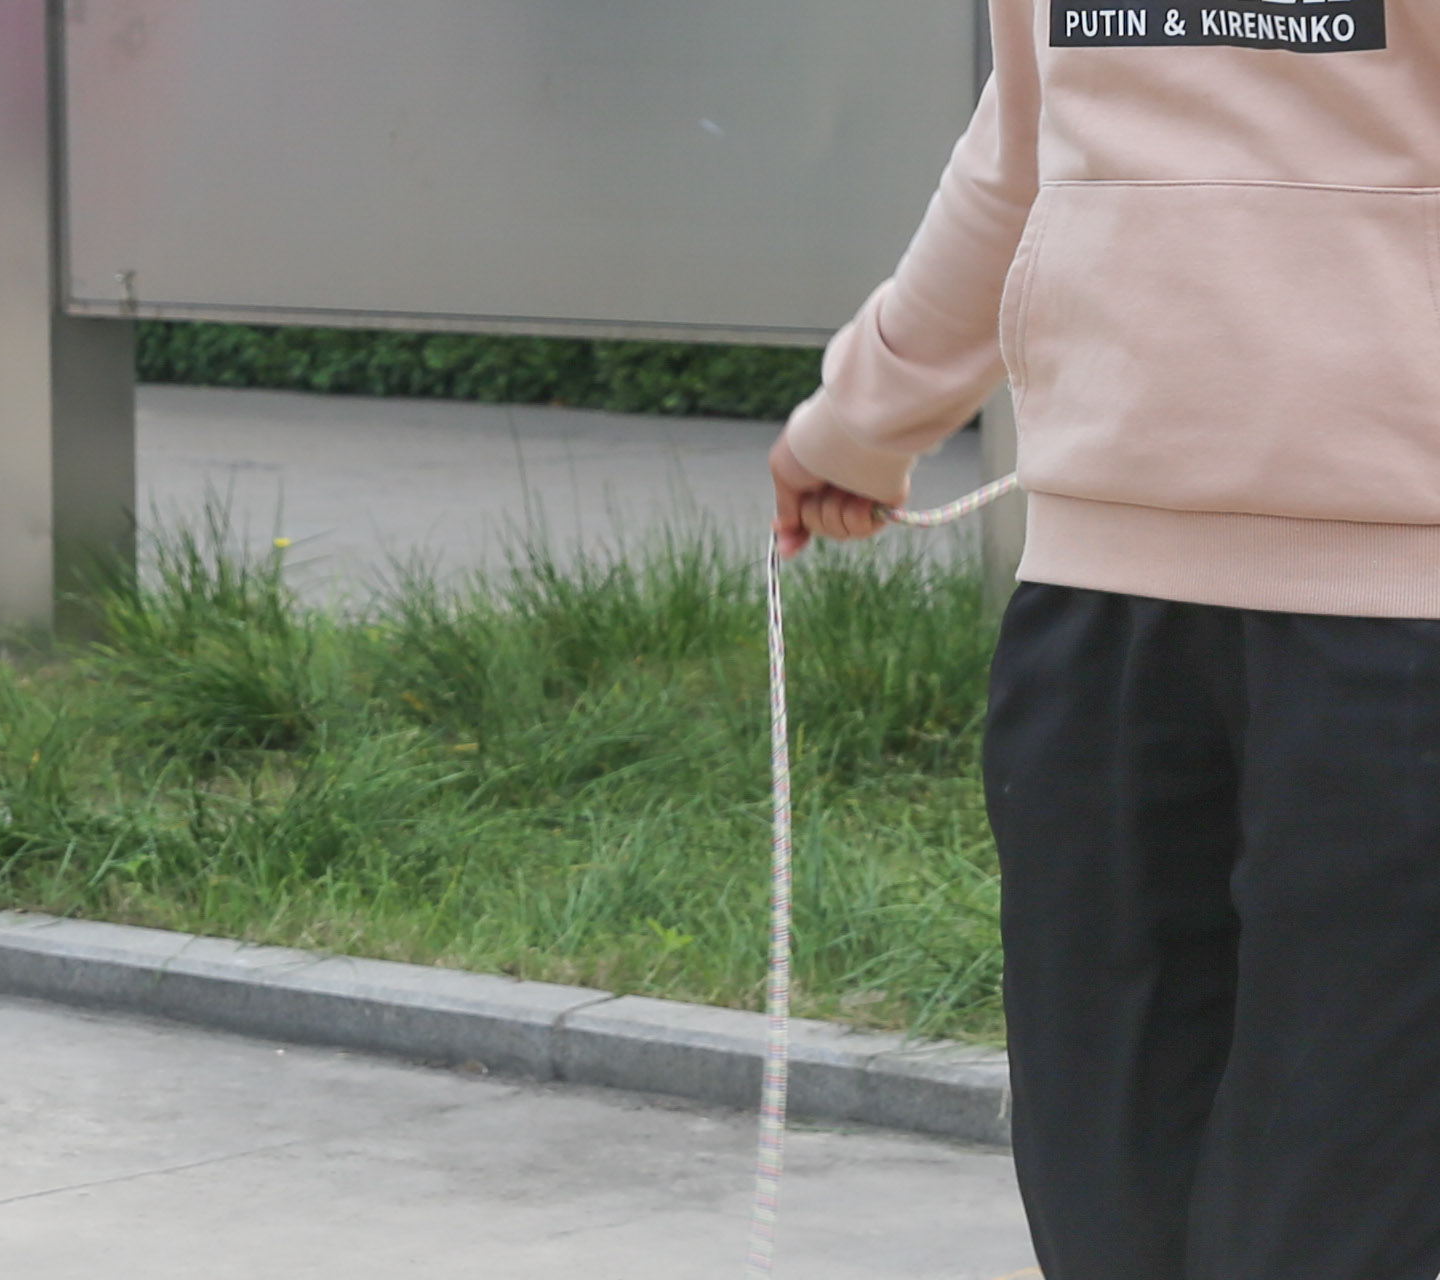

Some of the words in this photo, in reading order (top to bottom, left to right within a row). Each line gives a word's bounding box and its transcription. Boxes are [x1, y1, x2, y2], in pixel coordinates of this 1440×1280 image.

[1065, 9, 1147, 38] PUTIN
[1163, 8, 1187, 37] &
[1201, 9, 1356, 43] KIRENENKO
